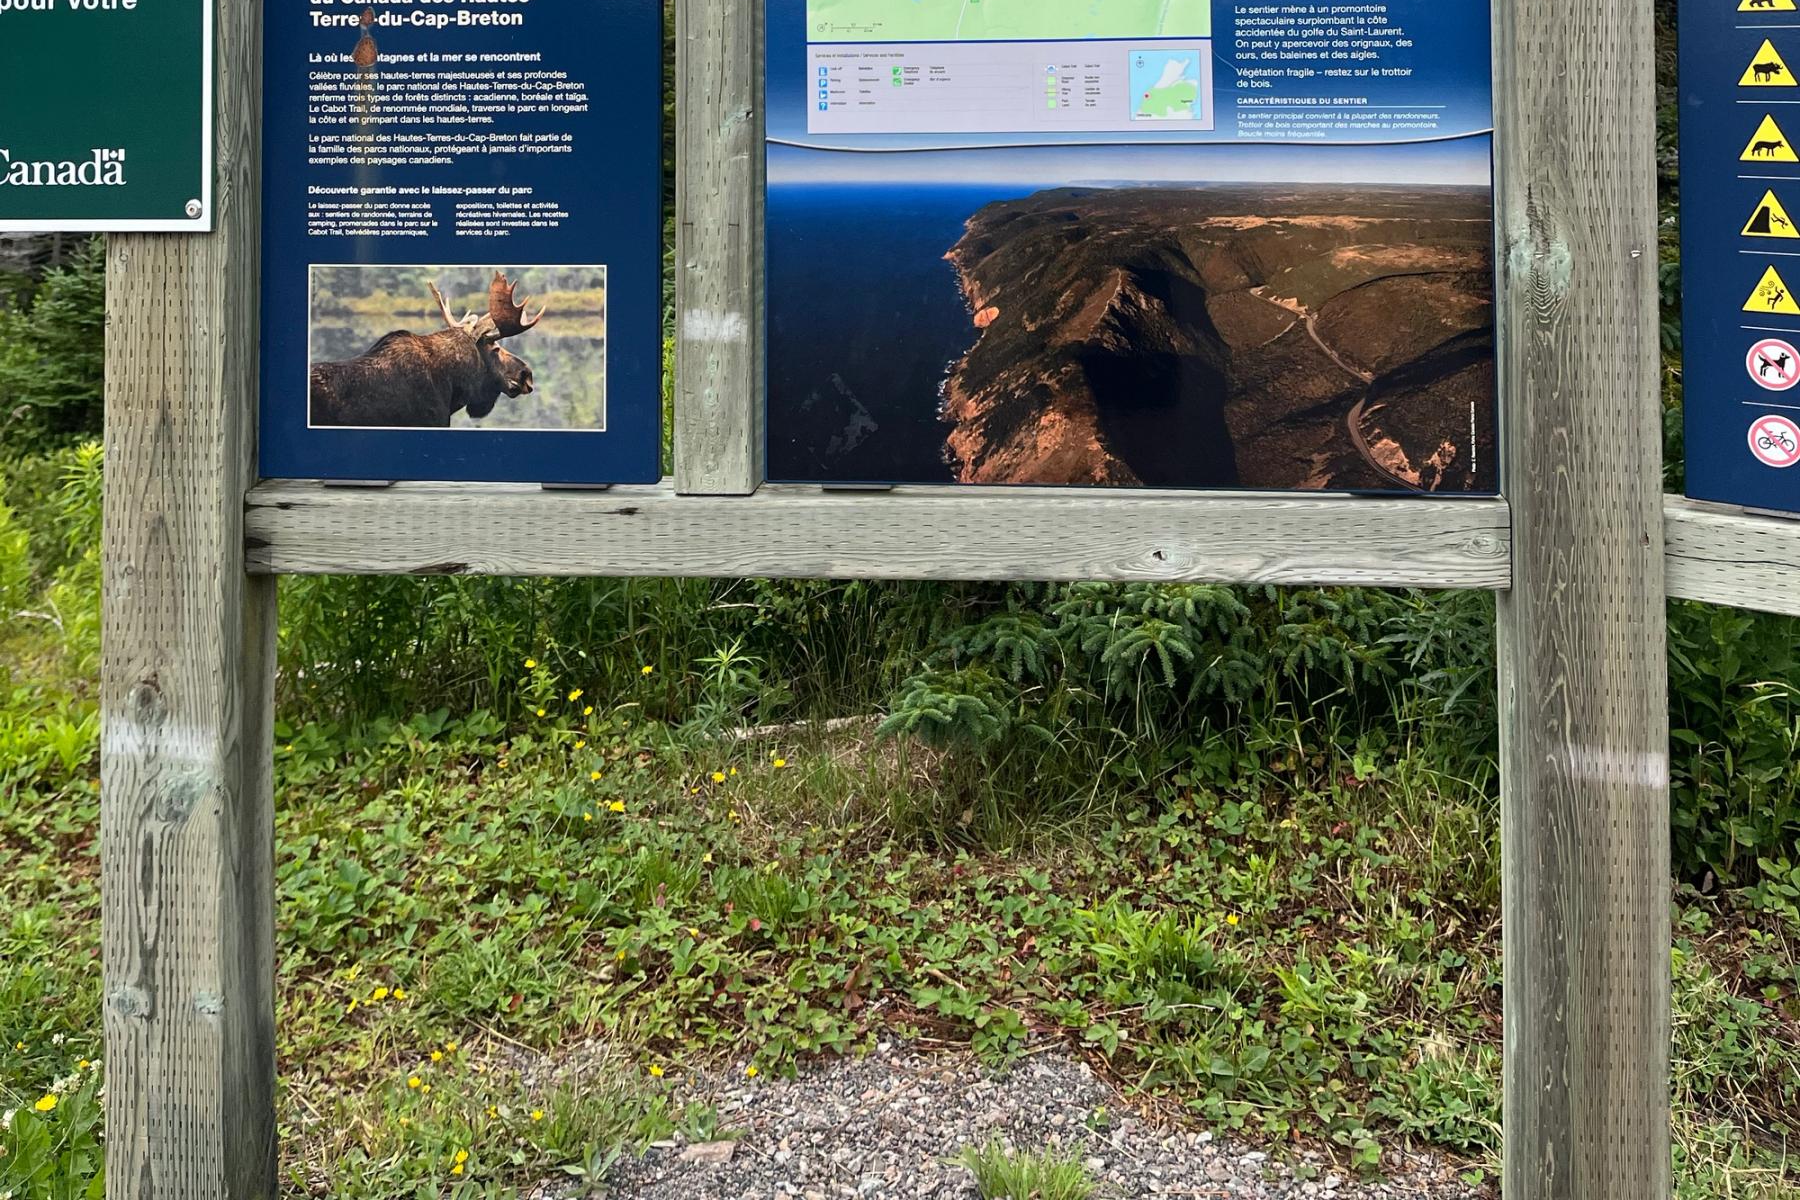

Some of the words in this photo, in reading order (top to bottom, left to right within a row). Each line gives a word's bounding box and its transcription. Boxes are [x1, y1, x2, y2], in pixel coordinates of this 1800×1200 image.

[1248, 5, 1279, 13] sentier
[1281, 5, 1306, 13] mène
[1309, 4, 1314, 13] à
[1331, 4, 1386, 14] promontoire
[309, 10, 522, 29] Terre-du-Cap-Breton
